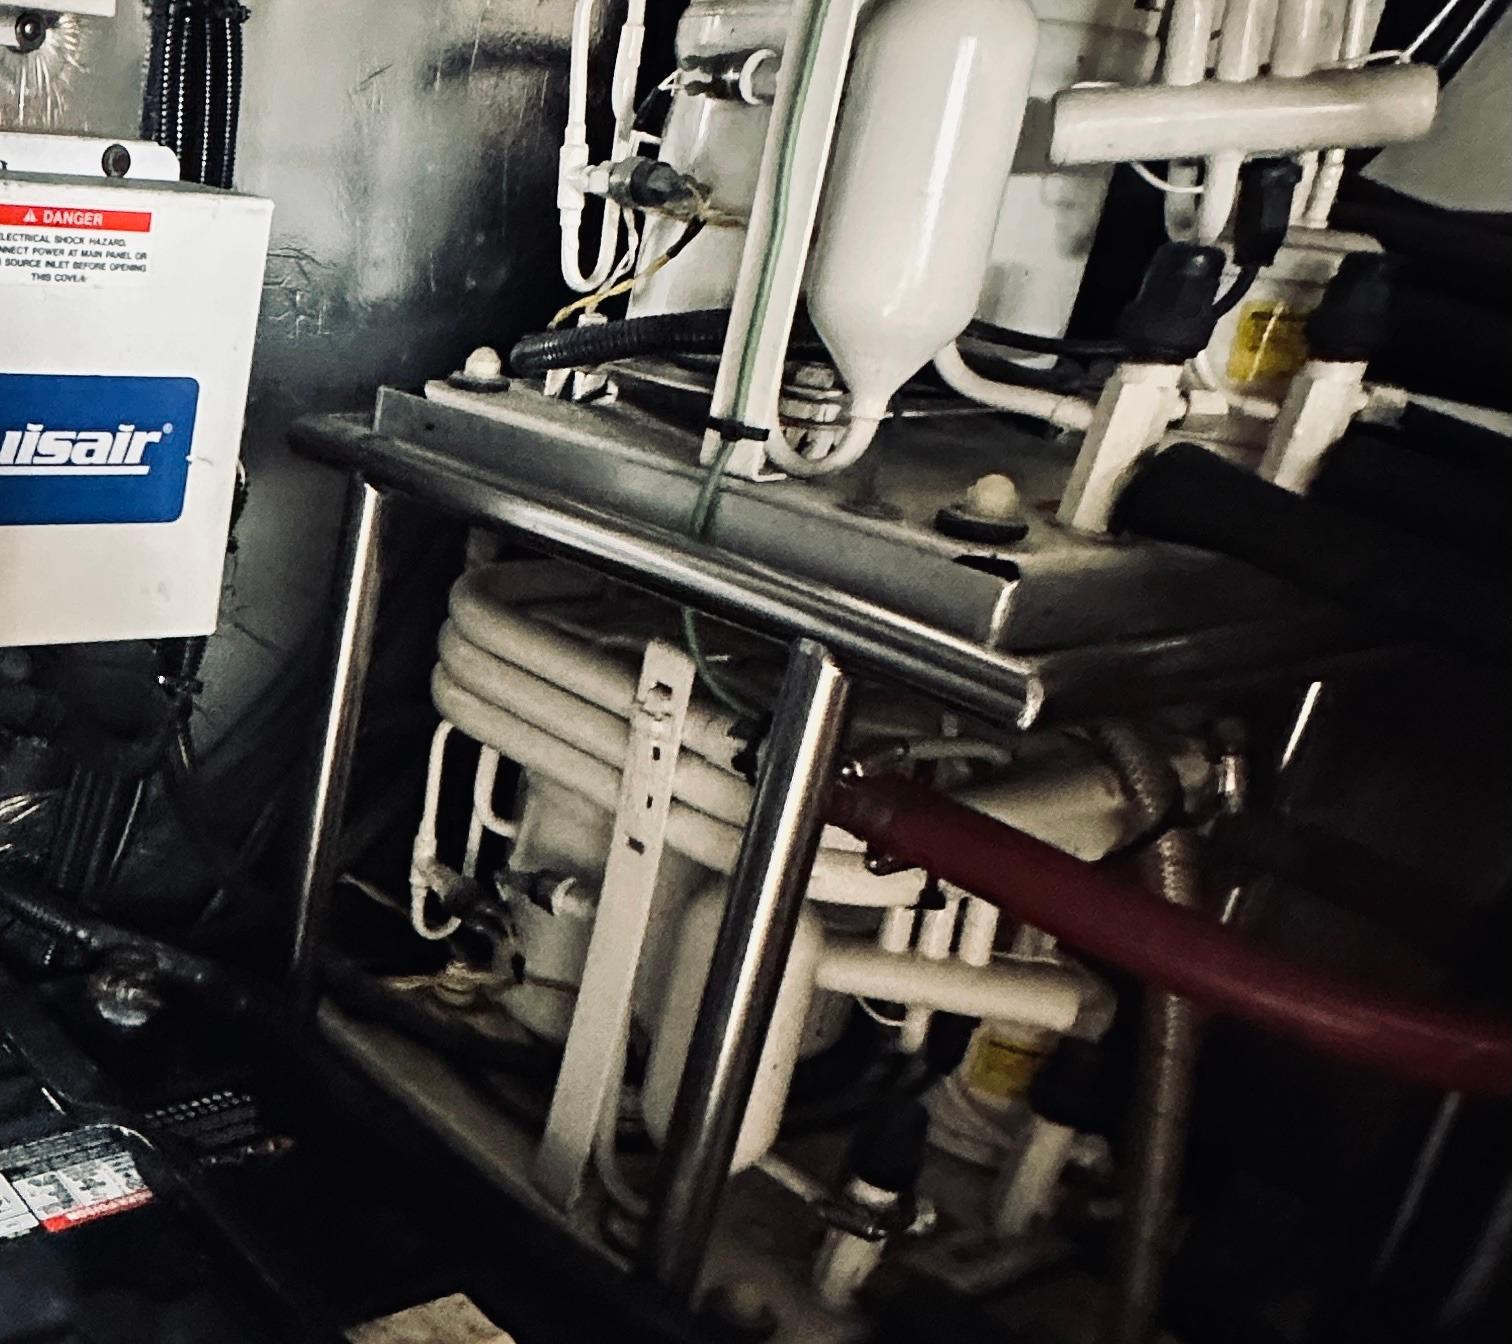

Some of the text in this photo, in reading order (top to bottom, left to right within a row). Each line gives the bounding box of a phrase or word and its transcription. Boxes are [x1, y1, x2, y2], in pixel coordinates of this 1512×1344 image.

[42, 209, 103, 226] DANGER
[55, 235, 85, 244] SHOCK
[32, 247, 64, 256] POWER
[81, 250, 102, 258] MAIN
[106, 251, 132, 259] PANEL
[135, 252, 147, 260] OR
[5, 258, 41, 267] SOURCE
[45, 261, 69, 269] INLET
[73, 261, 106, 270] BEFORE
[110, 263, 146, 272] OPENING
[31, 273, 51, 281] THIS
